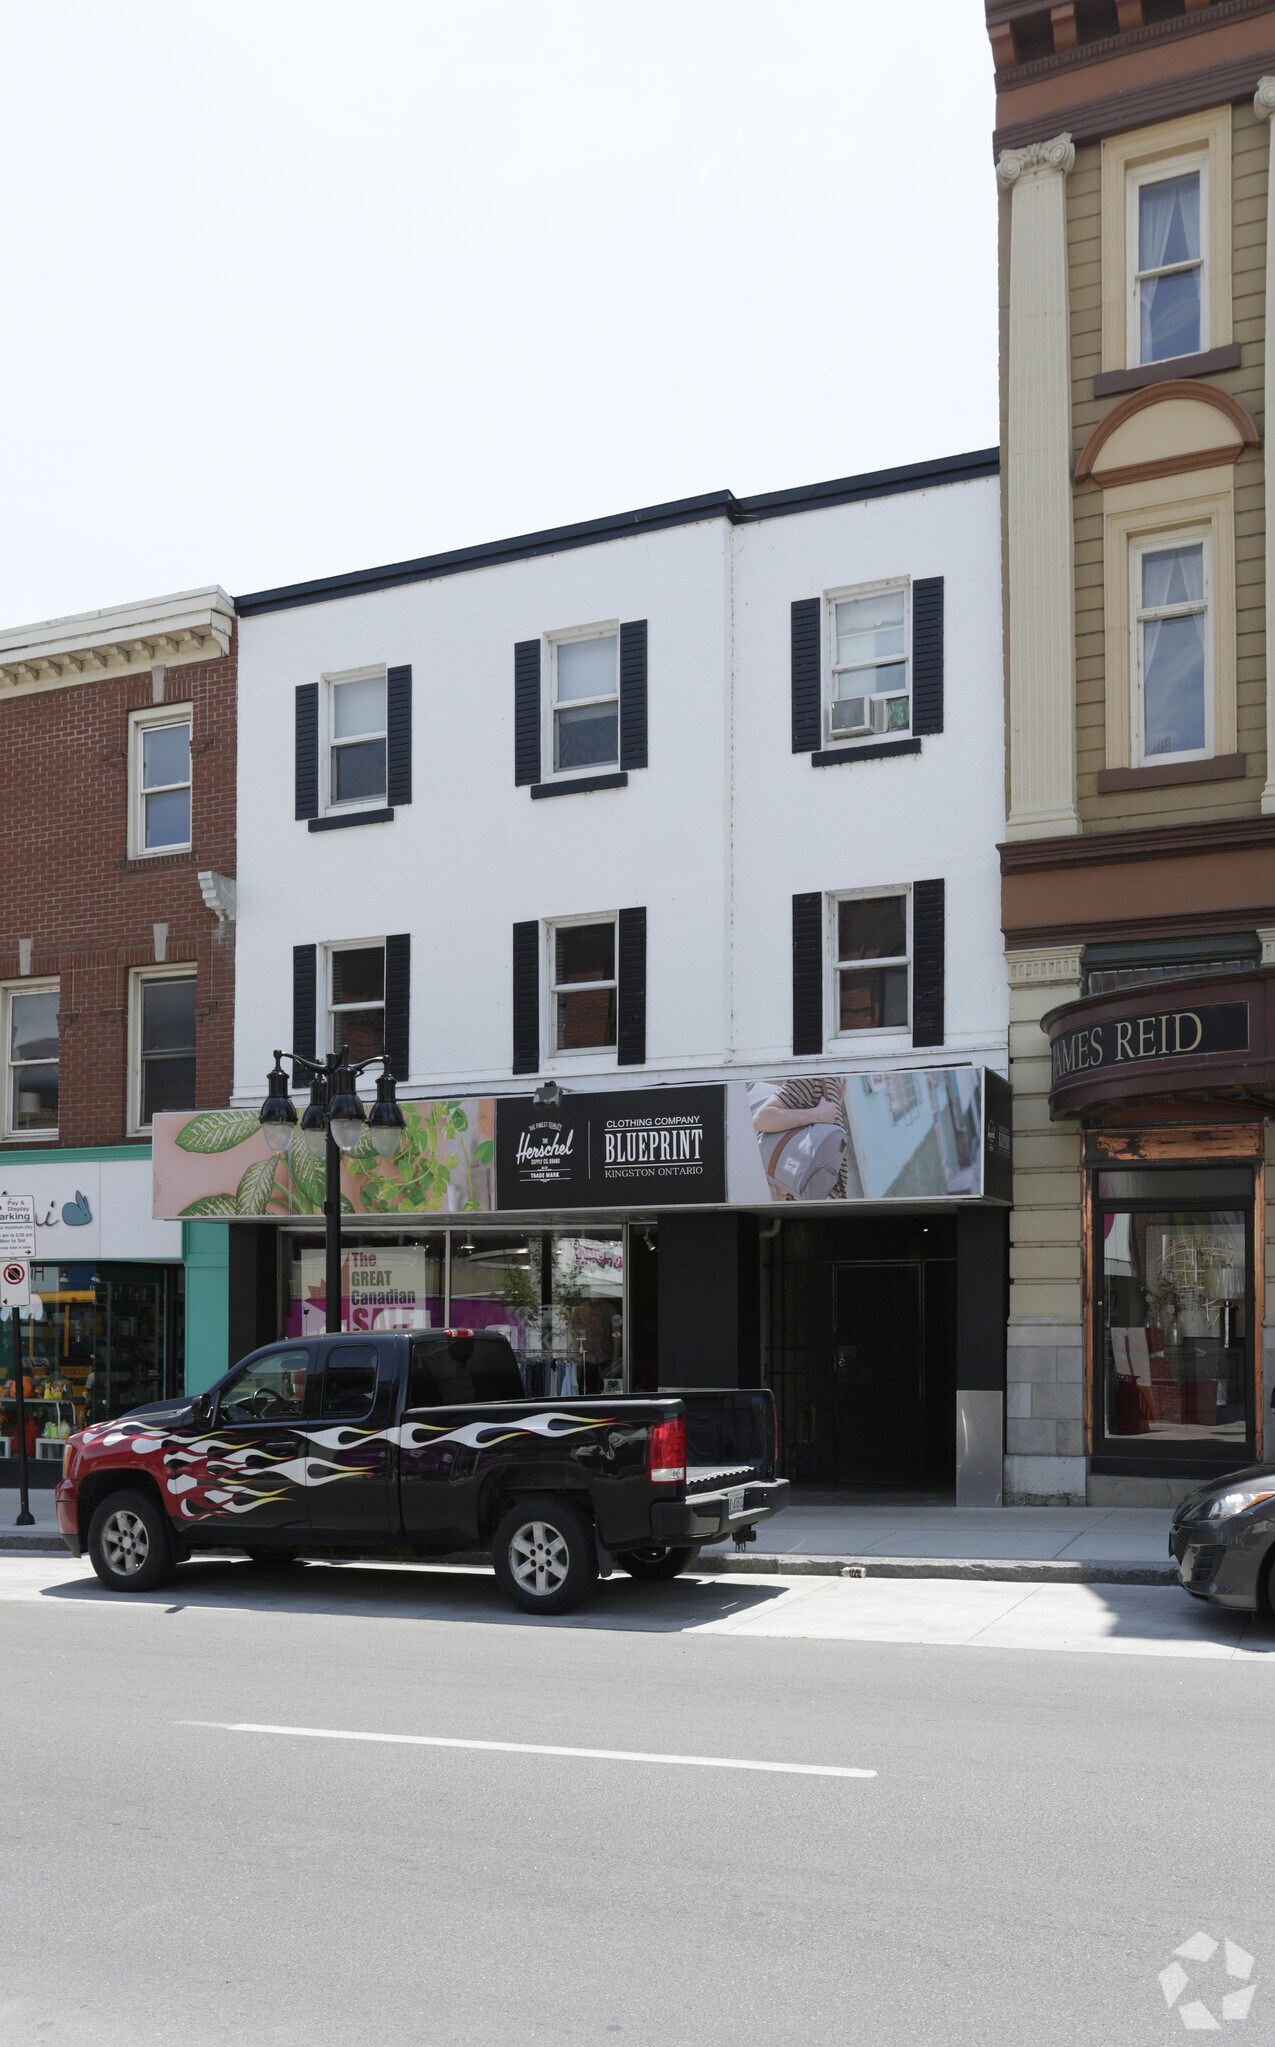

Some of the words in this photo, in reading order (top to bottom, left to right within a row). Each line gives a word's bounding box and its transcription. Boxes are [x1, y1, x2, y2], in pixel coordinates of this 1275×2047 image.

[1053, 1027, 1103, 1079] AMES
[1114, 1012, 1202, 1061] REID
[606, 1118, 652, 1129] CLOTHING
[654, 1115, 701, 1126] COMPANY
[516, 1129, 574, 1165] Herschel
[605, 1129, 703, 1163] BLUEPRINT
[605, 1168, 655, 1178] KINGSTON
[658, 1166, 703, 1176] ONTARIO
[0, 1213, 30, 1222] arking
[351, 1252, 377, 1268] The
[351, 1270, 393, 1287] GREAT
[351, 1289, 416, 1306] Canadian
